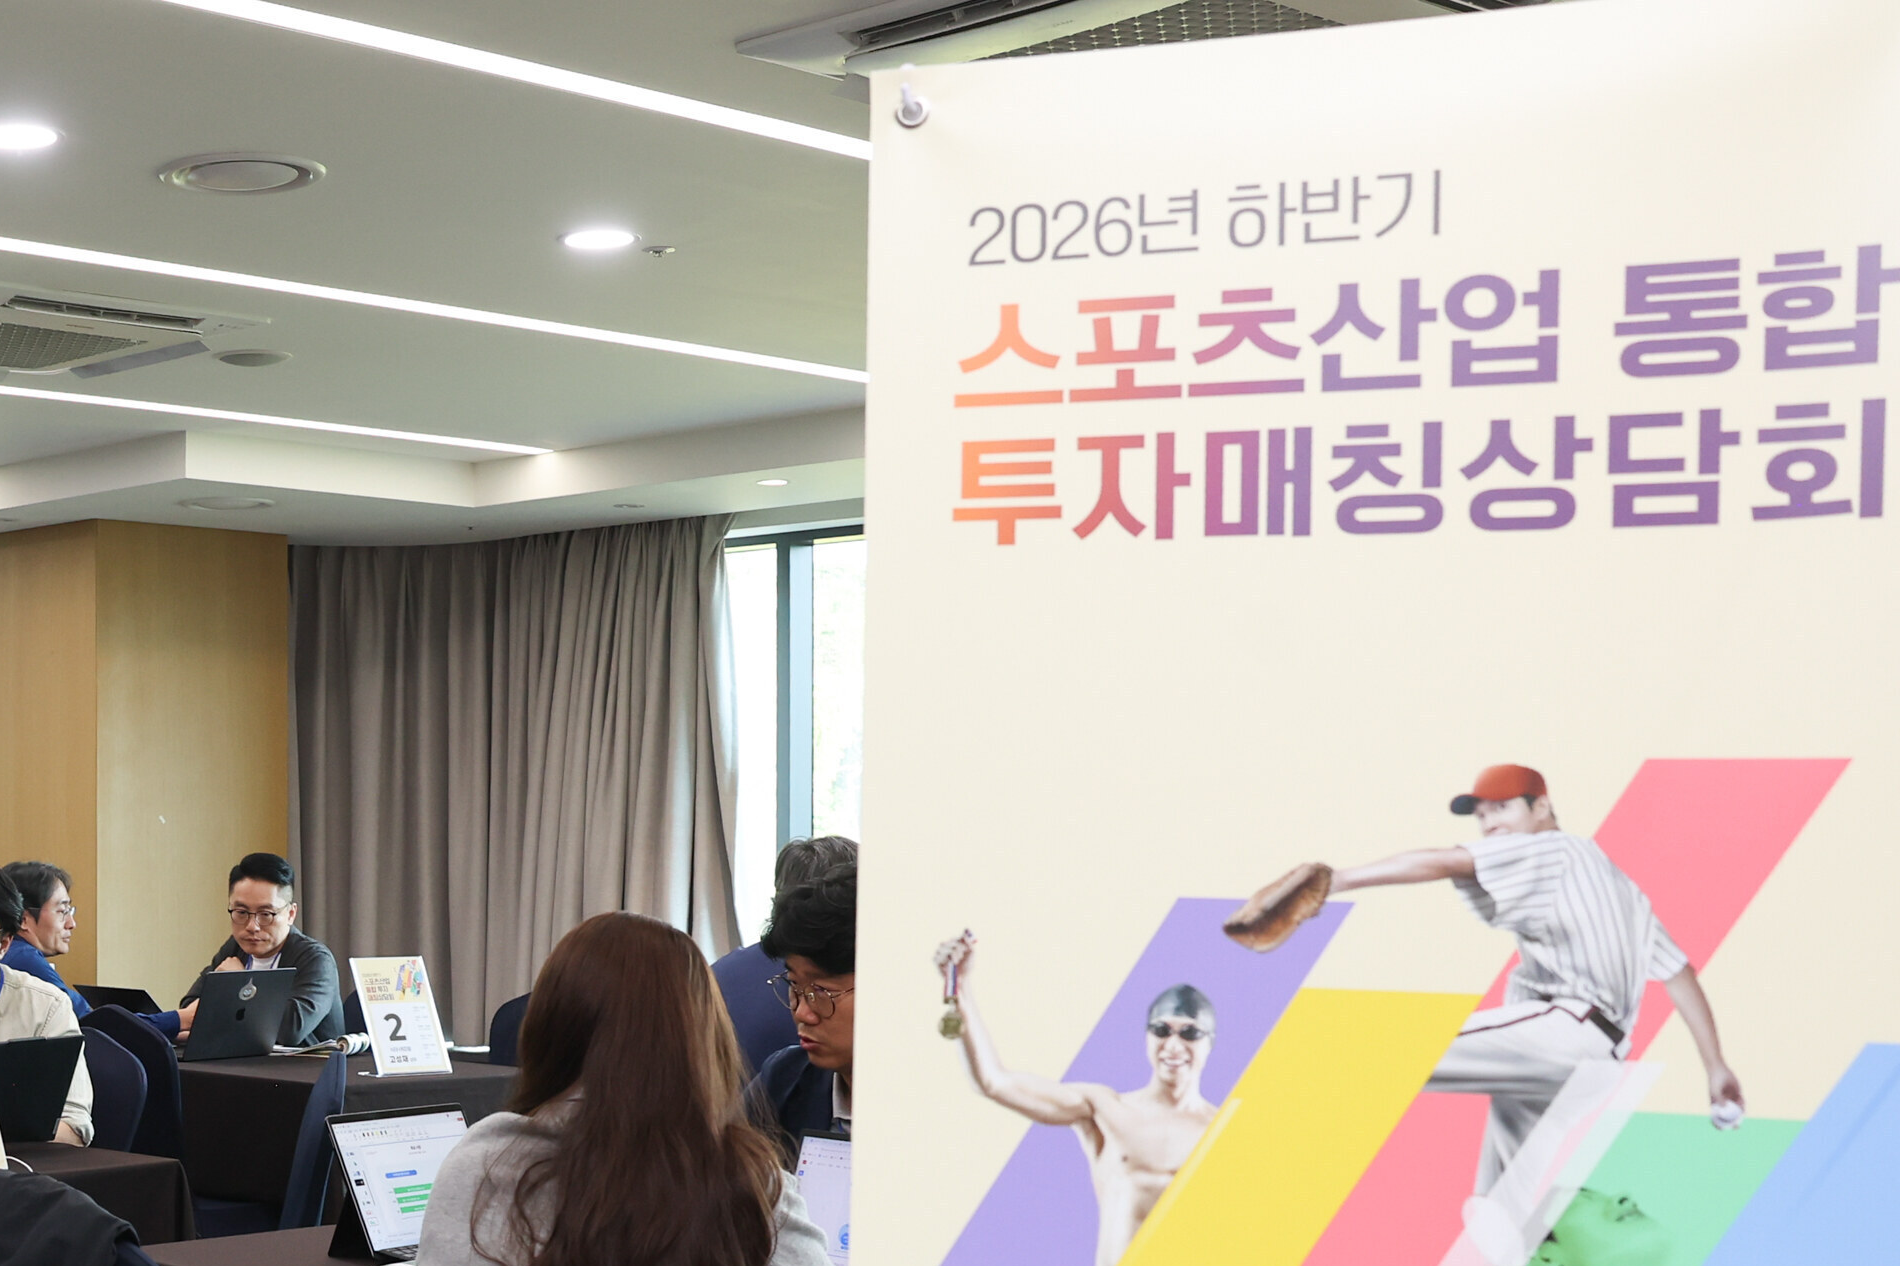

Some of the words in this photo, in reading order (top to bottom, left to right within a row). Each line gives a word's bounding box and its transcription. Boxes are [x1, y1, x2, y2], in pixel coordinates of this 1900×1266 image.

[968, 188, 1200, 267] 2026년
[1227, 169, 1442, 249] 하반기
[954, 268, 1561, 408] 스포츠산업
[1614, 244, 1900, 379] 통합
[952, 397, 1887, 546] 투자매칭상담회
[383, 1013, 407, 1042] 2
